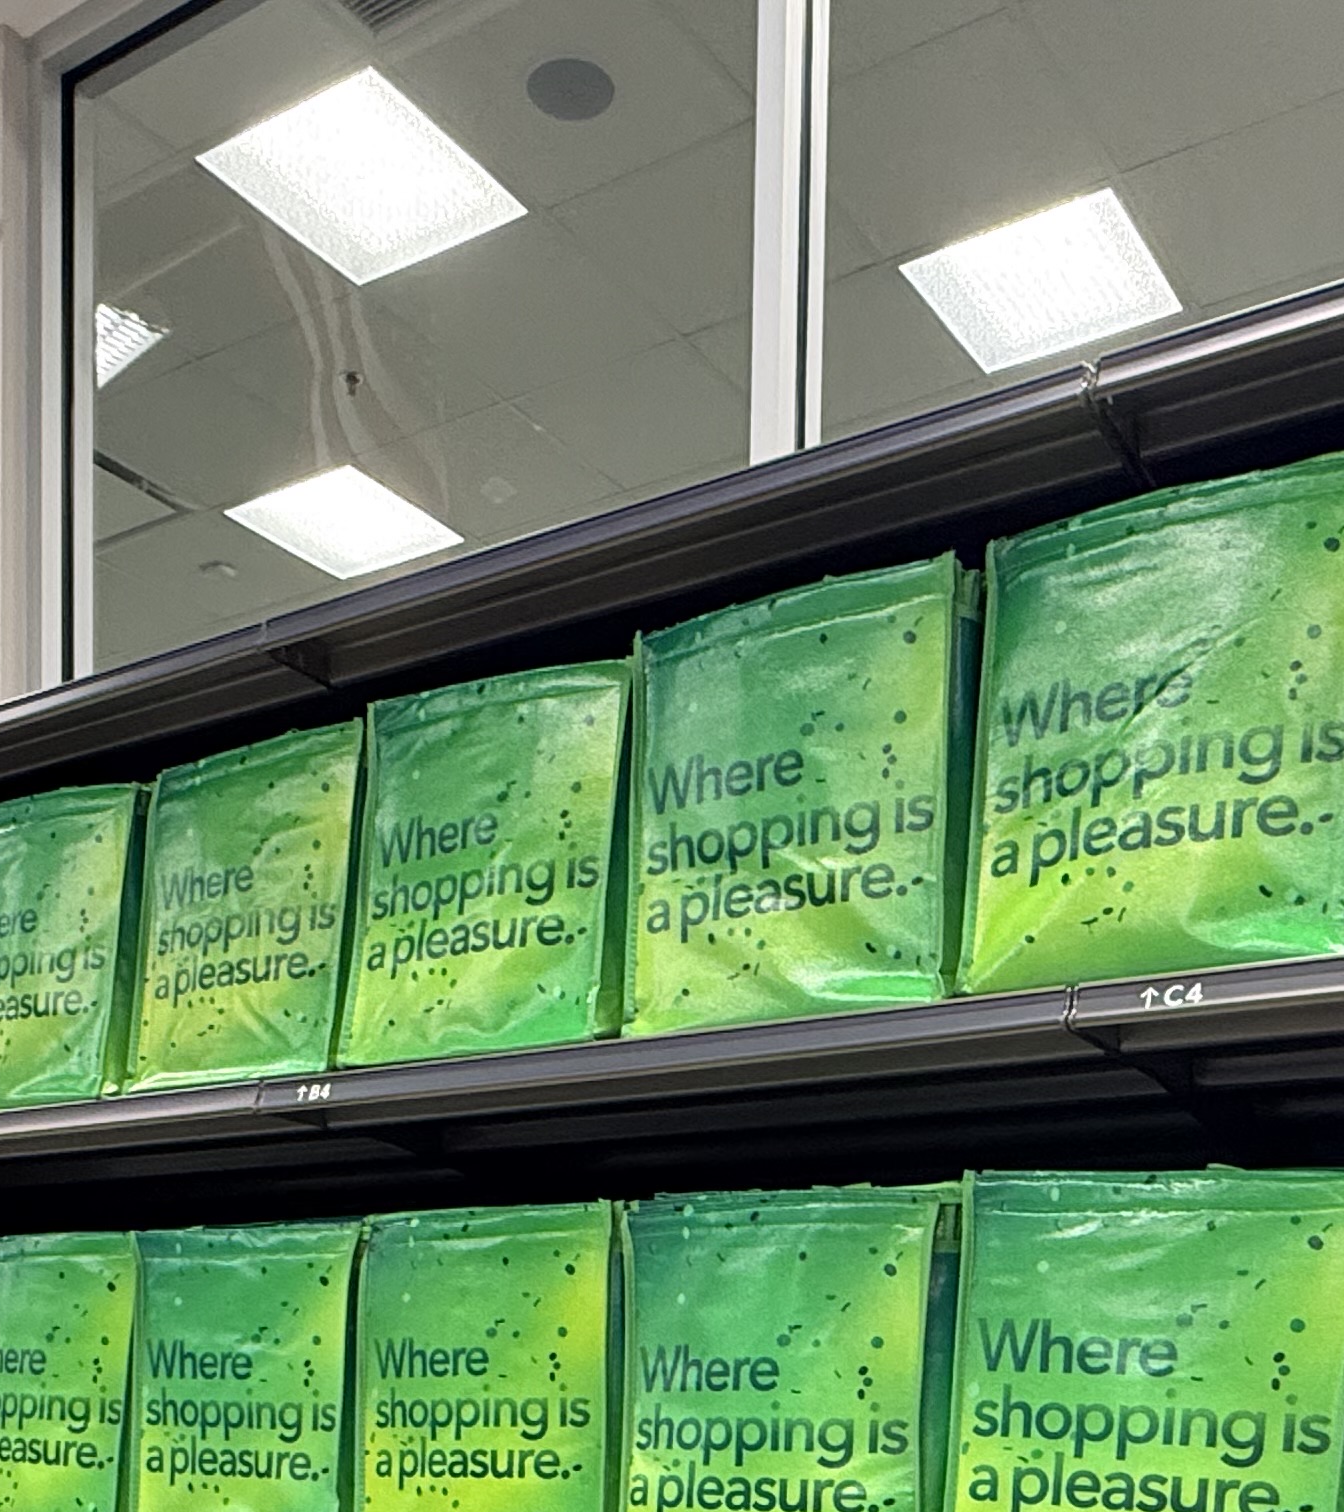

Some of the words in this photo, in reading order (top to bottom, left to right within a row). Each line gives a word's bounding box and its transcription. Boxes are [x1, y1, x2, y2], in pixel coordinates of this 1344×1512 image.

[998, 671, 1194, 747] Where
[648, 750, 804, 815] Where
[993, 721, 1283, 815] shopping
[377, 810, 498, 868] Where
[646, 800, 880, 877] shopping
[895, 795, 935, 833] is
[990, 836, 1020, 878] a
[1029, 796, 1313, 886] pleasure.
[372, 855, 555, 921] shopping
[568, 854, 599, 890] is
[647, 900, 671, 936] a
[681, 862, 906, 943] pleasure.
[367, 942, 384, 972] a
[390, 912, 574, 981] pleasure.
[1164, 983, 1203, 1006] C4
[308, 1083, 331, 1100] B4
[148, 1340, 253, 1380] Where
[374, 1337, 489, 1380] Where
[979, 1318, 1179, 1378] Where
[145, 1387, 303, 1443] shopping
[311, 1401, 337, 1433] is
[375, 1388, 548, 1441] shopping
[560, 1396, 590, 1428] is
[972, 1384, 1267, 1467] shopping
[1284, 1407, 1331, 1455] is
[146, 1446, 163, 1473] a
[169, 1439, 318, 1486] pleasure.
[375, 1450, 392, 1477] a
[398, 1441, 570, 1490] pleasure.
[968, 1464, 1000, 1502] a
